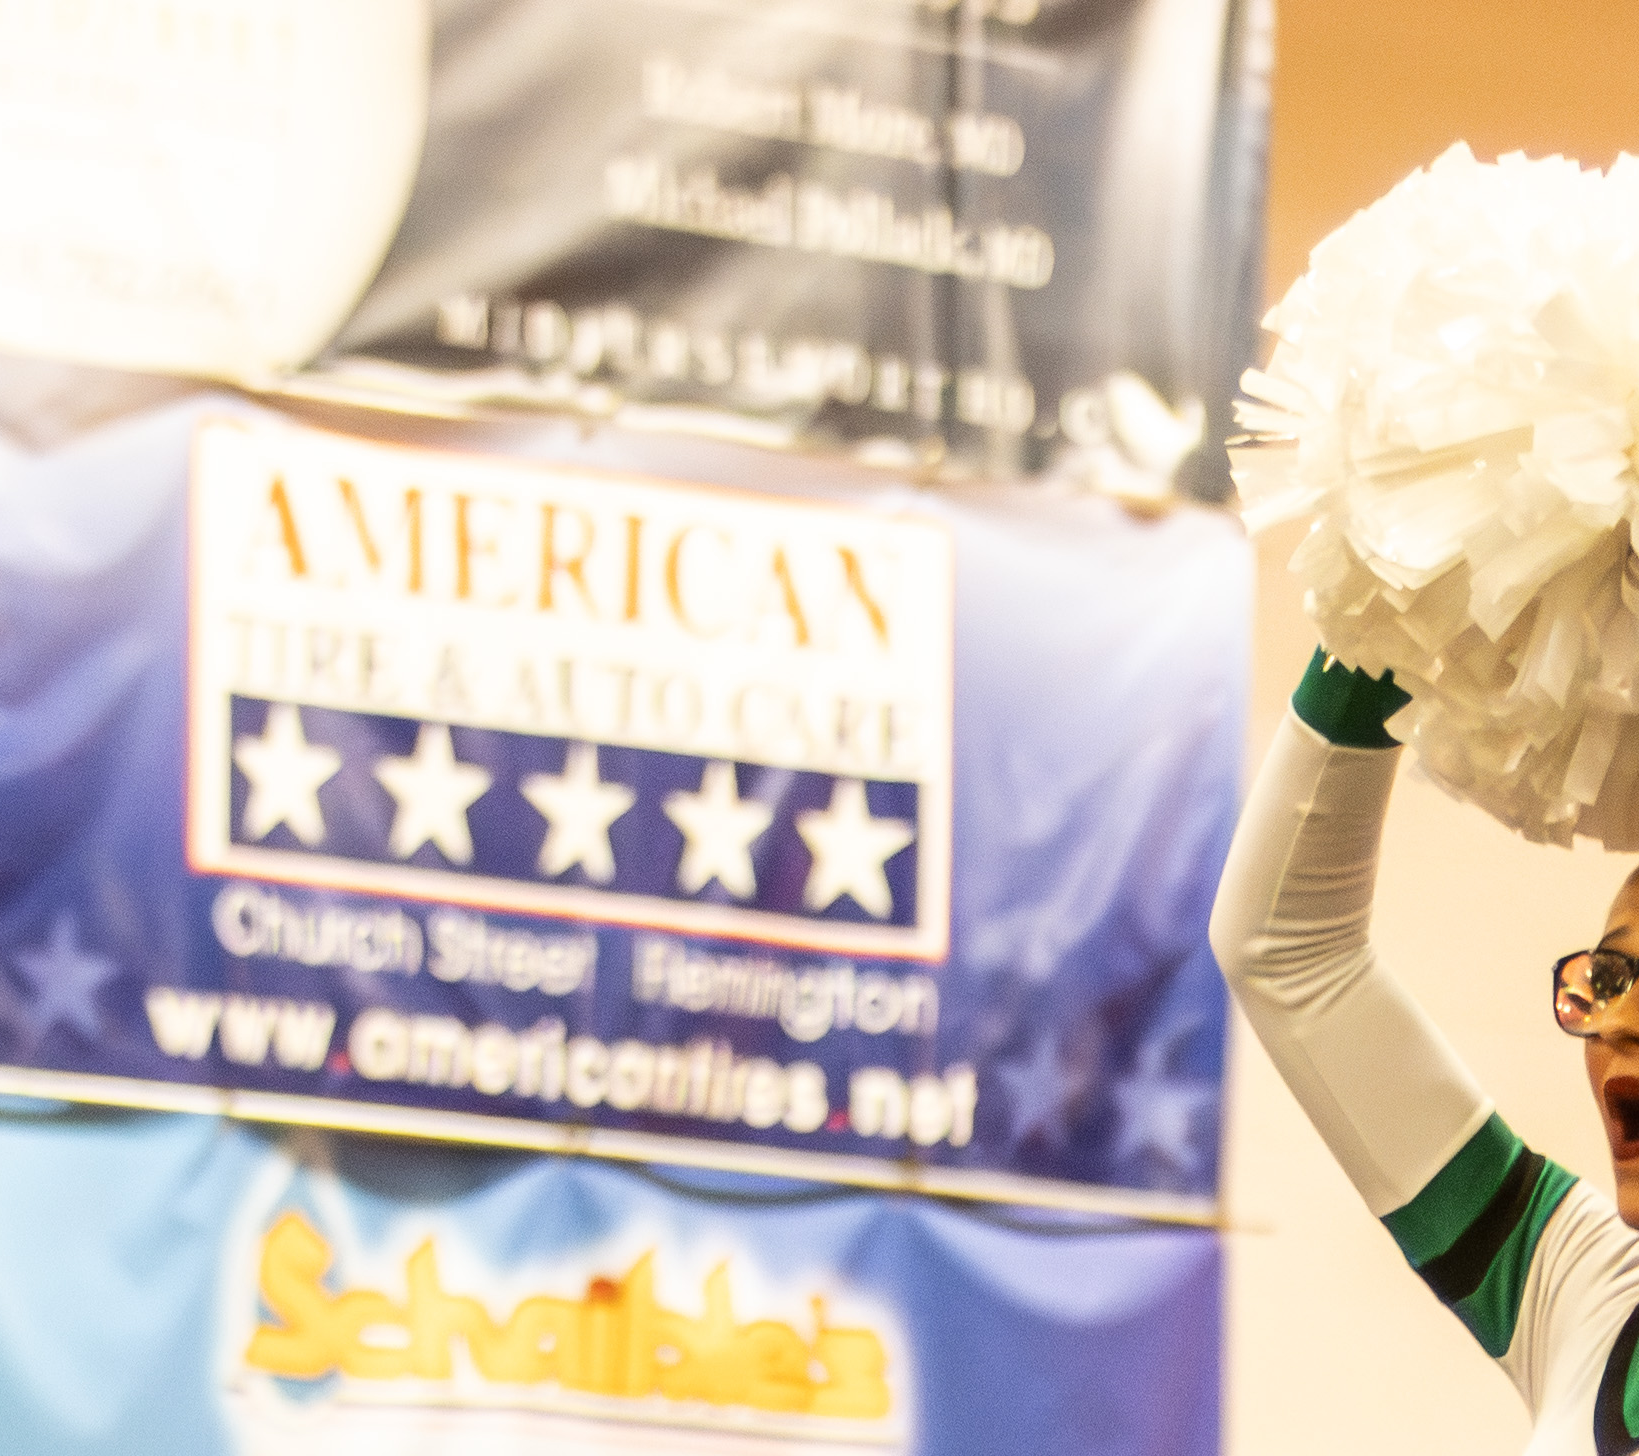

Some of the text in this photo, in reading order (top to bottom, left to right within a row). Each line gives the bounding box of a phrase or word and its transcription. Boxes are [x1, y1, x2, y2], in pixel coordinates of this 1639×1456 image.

[240, 467, 898, 650] AMERICAN
[225, 612, 398, 708] TIRE
[725, 678, 929, 773] CARE
[210, 882, 425, 980] Church
[428, 914, 599, 997] Street
